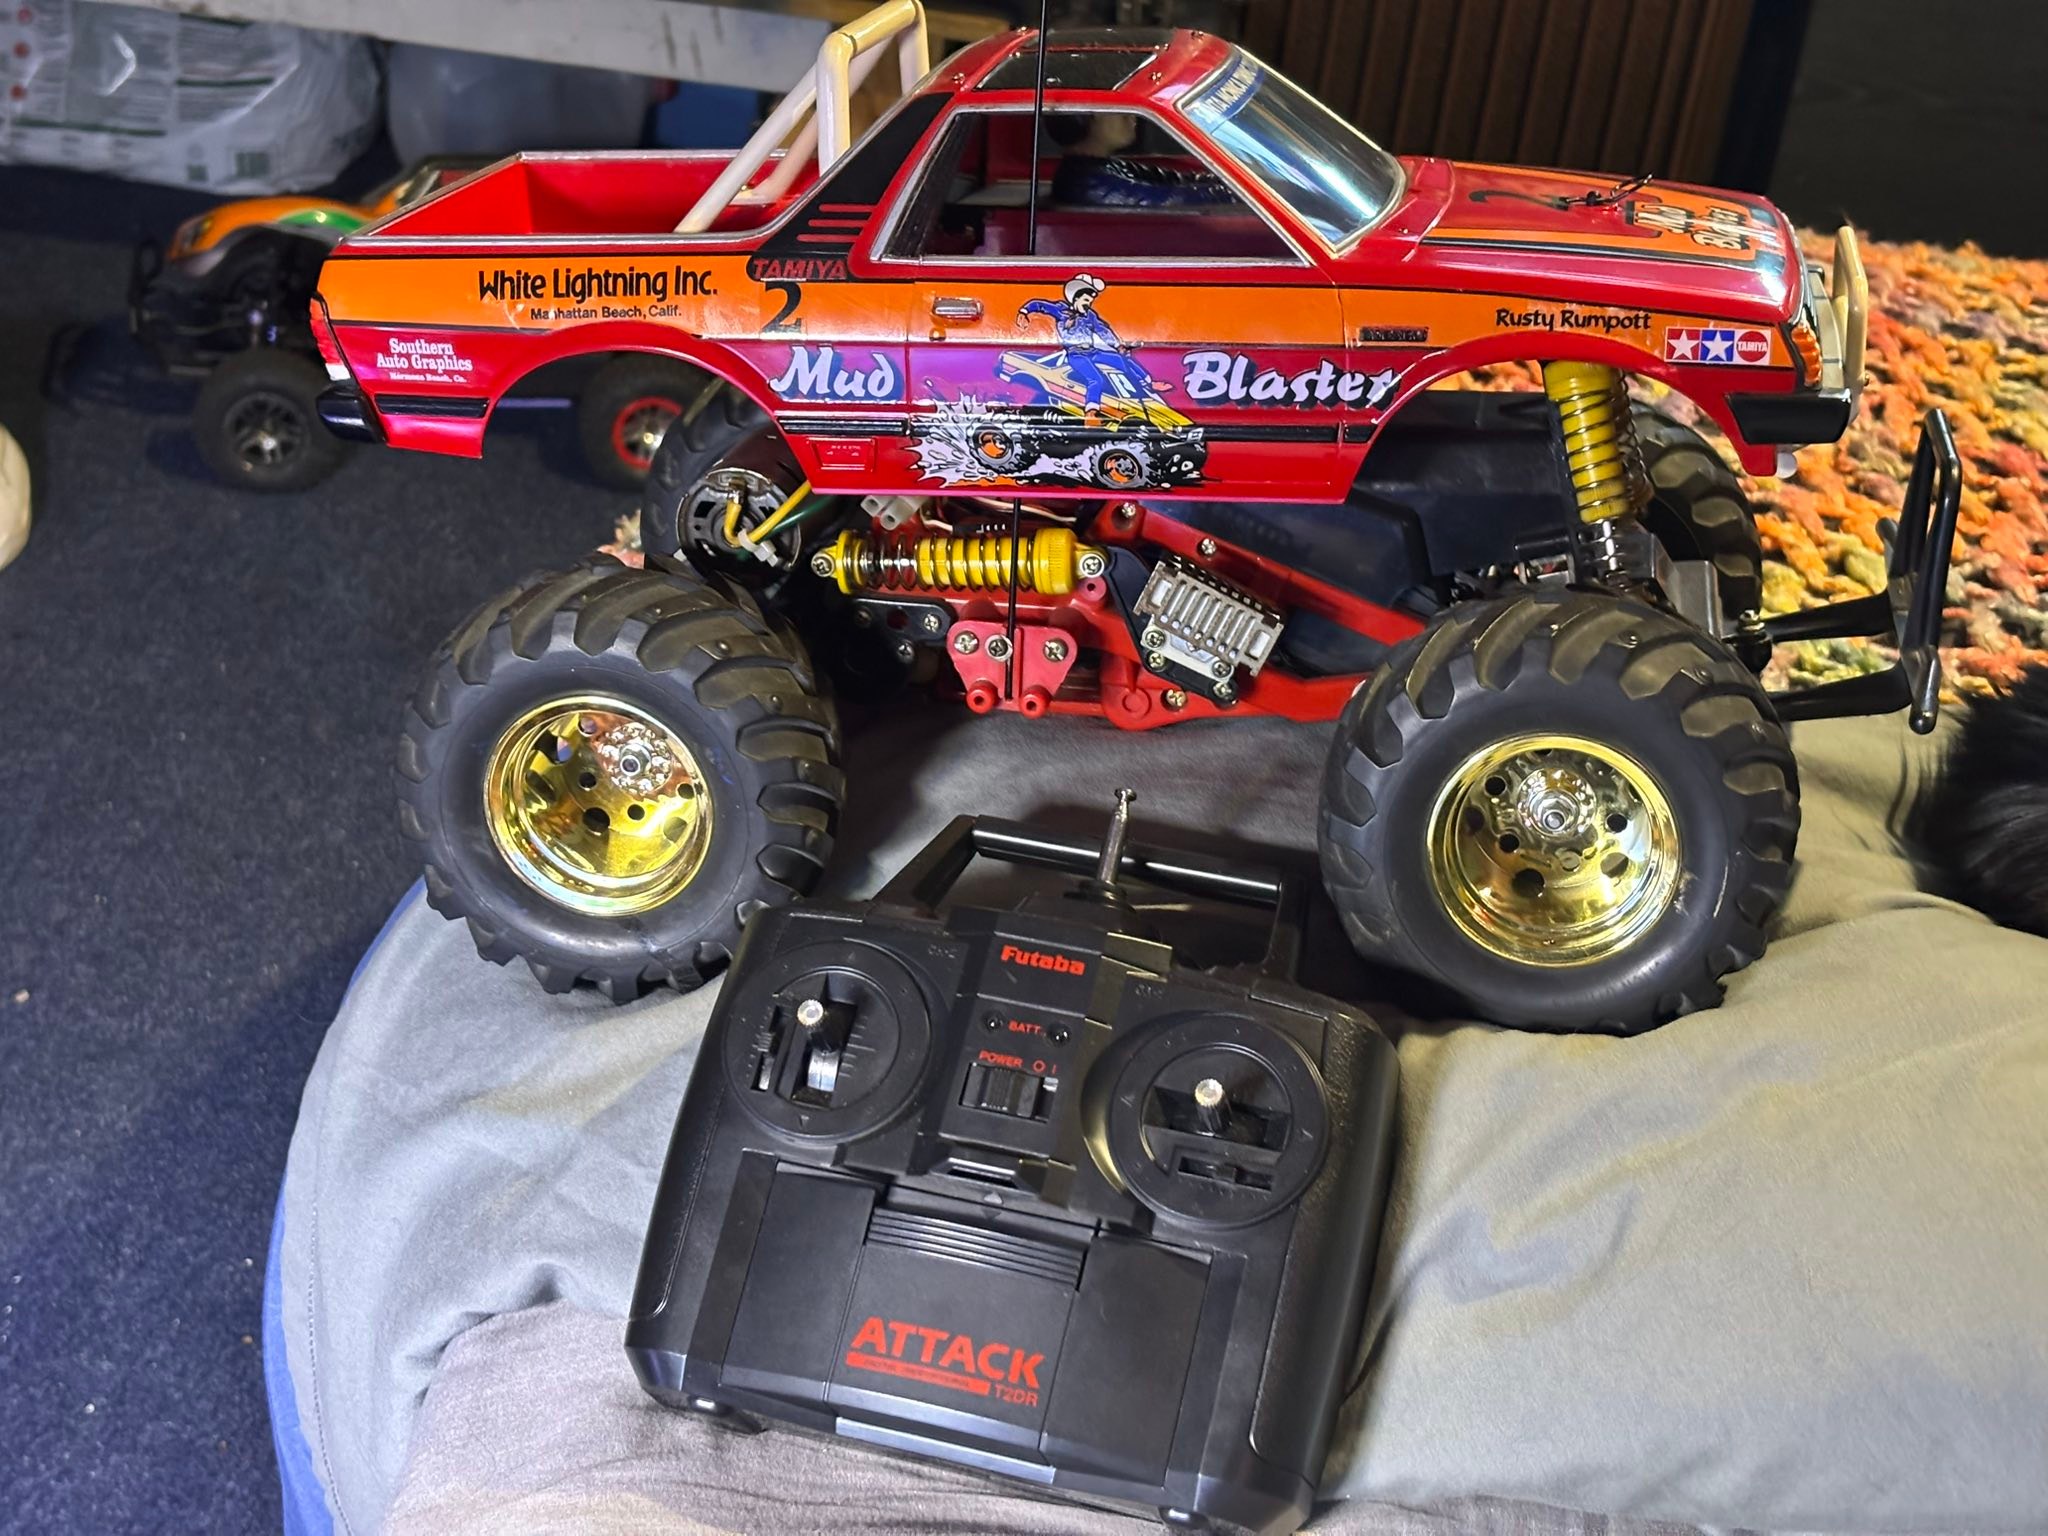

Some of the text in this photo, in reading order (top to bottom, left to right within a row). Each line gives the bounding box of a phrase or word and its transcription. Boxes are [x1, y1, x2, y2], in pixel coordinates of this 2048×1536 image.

[752, 257, 848, 280] TAMIYA
[478, 264, 718, 303] White Lightning Inc.
[530, 304, 683, 320] Manhattan Beach, Calif.
[761, 283, 803, 334] 2
[1495, 308, 1652, 332] Rusty Rumpott
[388, 337, 455, 356] Southern
[1736, 340, 1770, 353] TAMIYA
[376, 352, 474, 374] Auto Graphics
[769, 346, 1394, 403] Mud Blaster
[1001, 944, 1086, 976] Futaba
[978, 1050, 1023, 1068] POWER
[850, 1315, 1046, 1390] ATTACK
[994, 1383, 1039, 1408] T2DR
